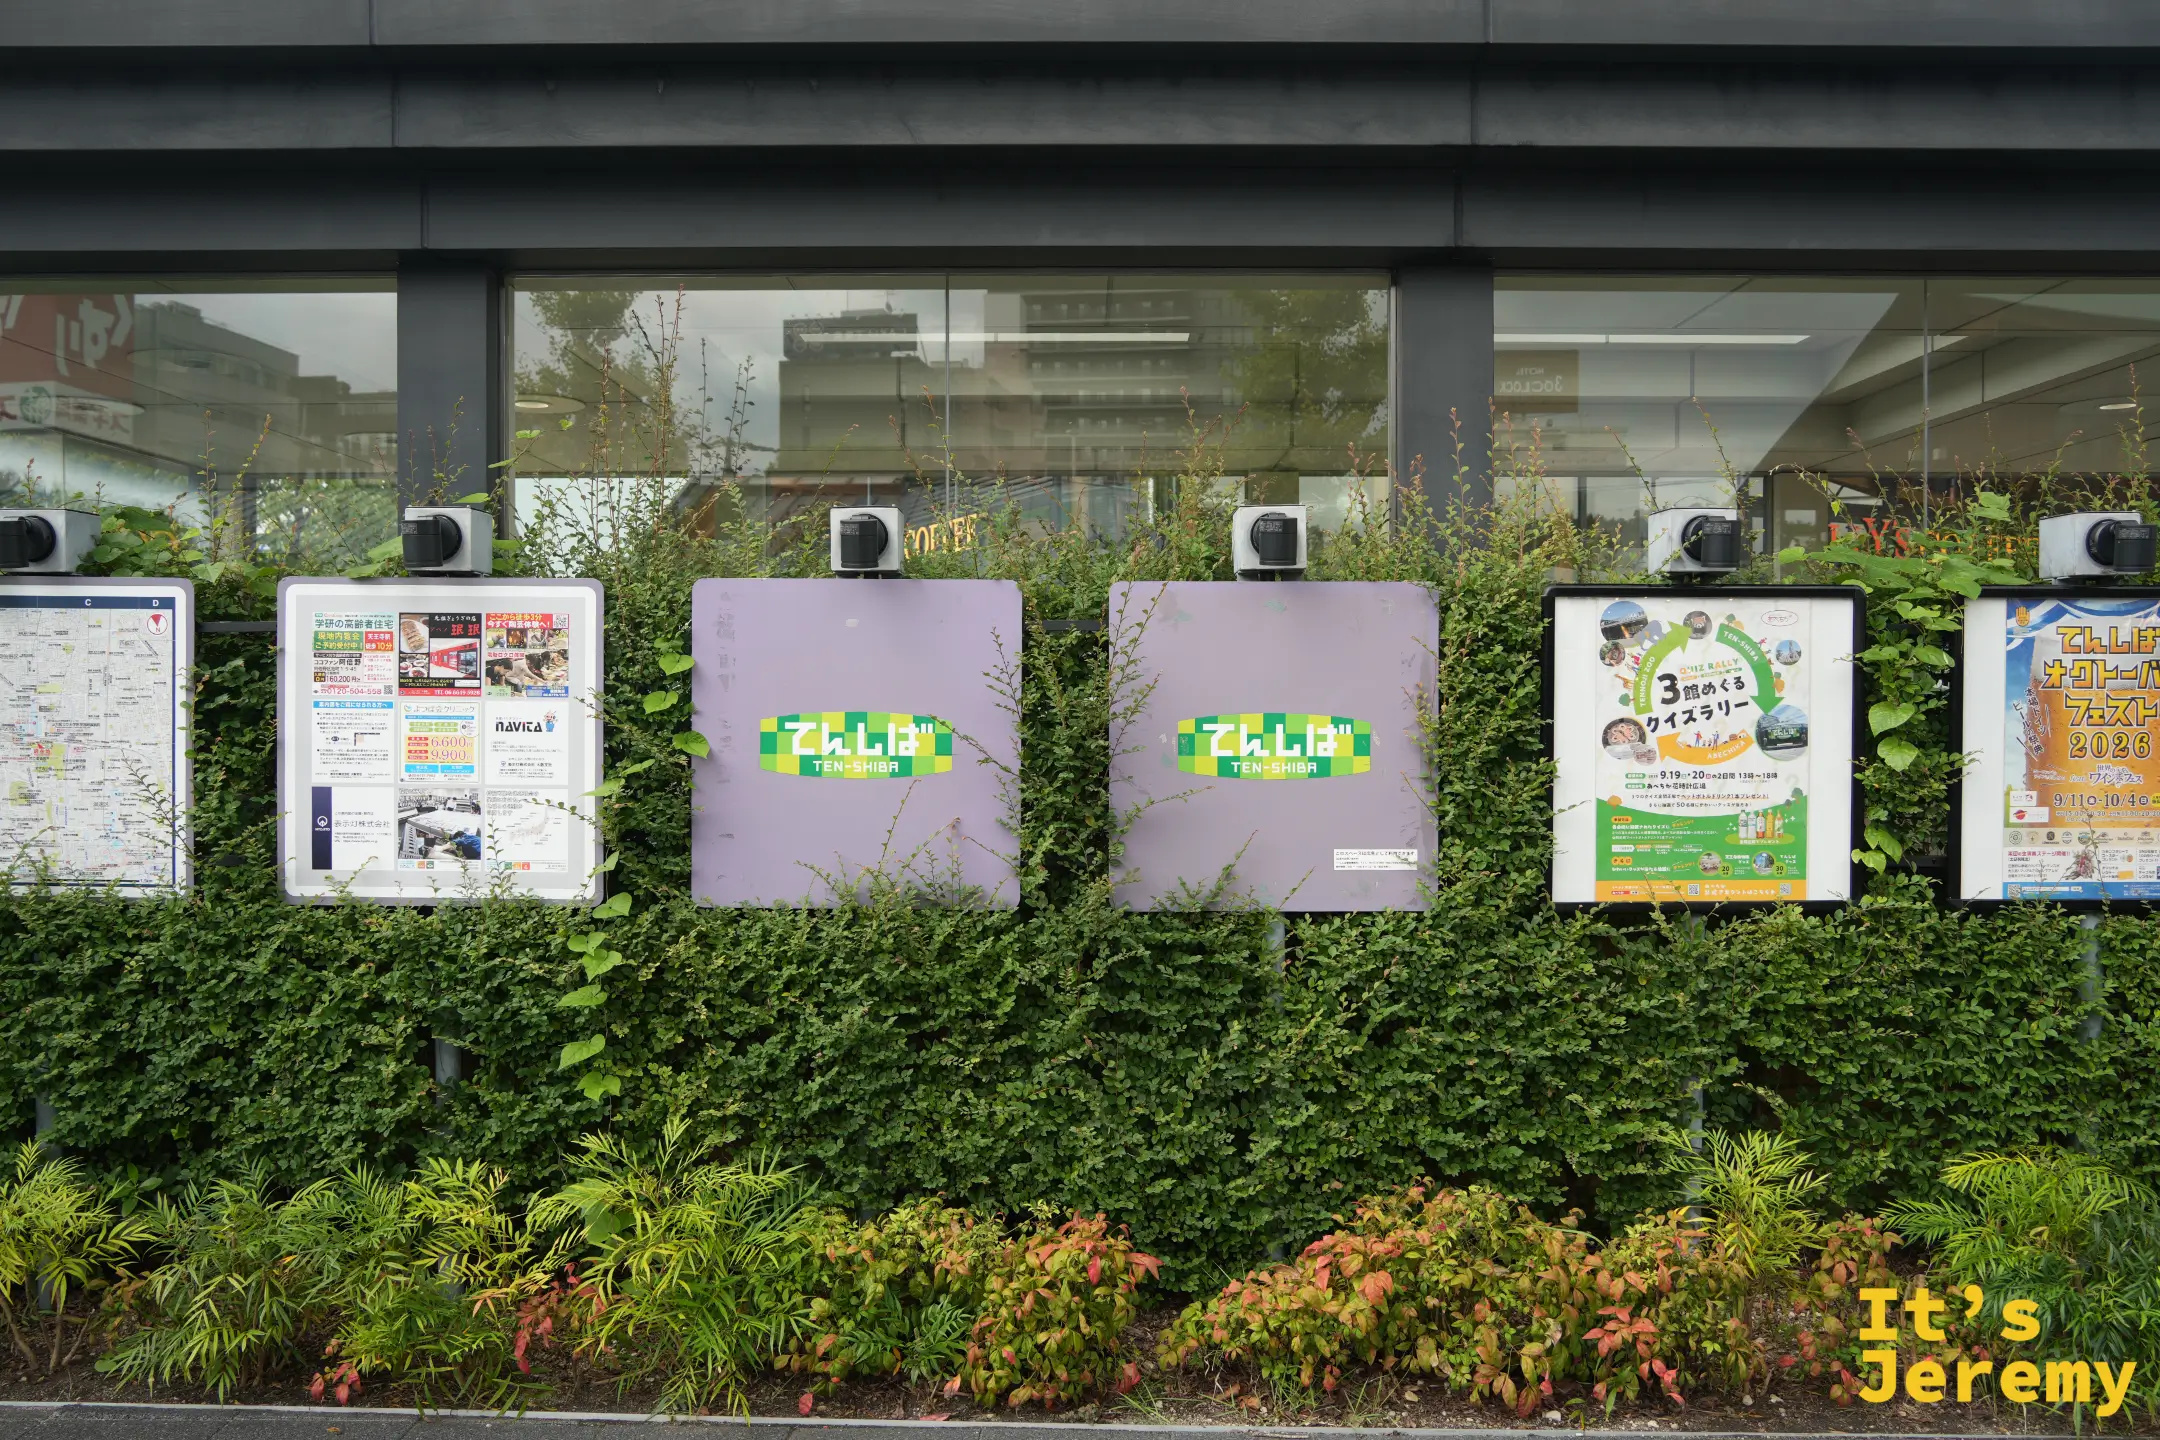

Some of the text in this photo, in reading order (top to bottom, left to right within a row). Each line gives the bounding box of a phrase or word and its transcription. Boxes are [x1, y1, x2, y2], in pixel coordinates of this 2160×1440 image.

[152, 599, 159, 607] D
[489, 613, 542, 621] ここから徒歩3分
[315, 619, 394, 629] 学研の高齢者住宅
[1723, 630, 1760, 662] TEN-SHIBA
[2056, 626, 2160, 655] てんしば
[1708, 658, 1739, 670] RALLY
[1646, 699, 1749, 734] クイズラリー
[2065, 692, 2158, 727] フェスト
[784, 722, 933, 756] てんしば
[1203, 724, 1351, 757] てんしば
[2069, 731, 2151, 759] 2026
[813, 760, 899, 772] TEN-SHIBA
[1231, 762, 1317, 773] TEN-SHIBA
